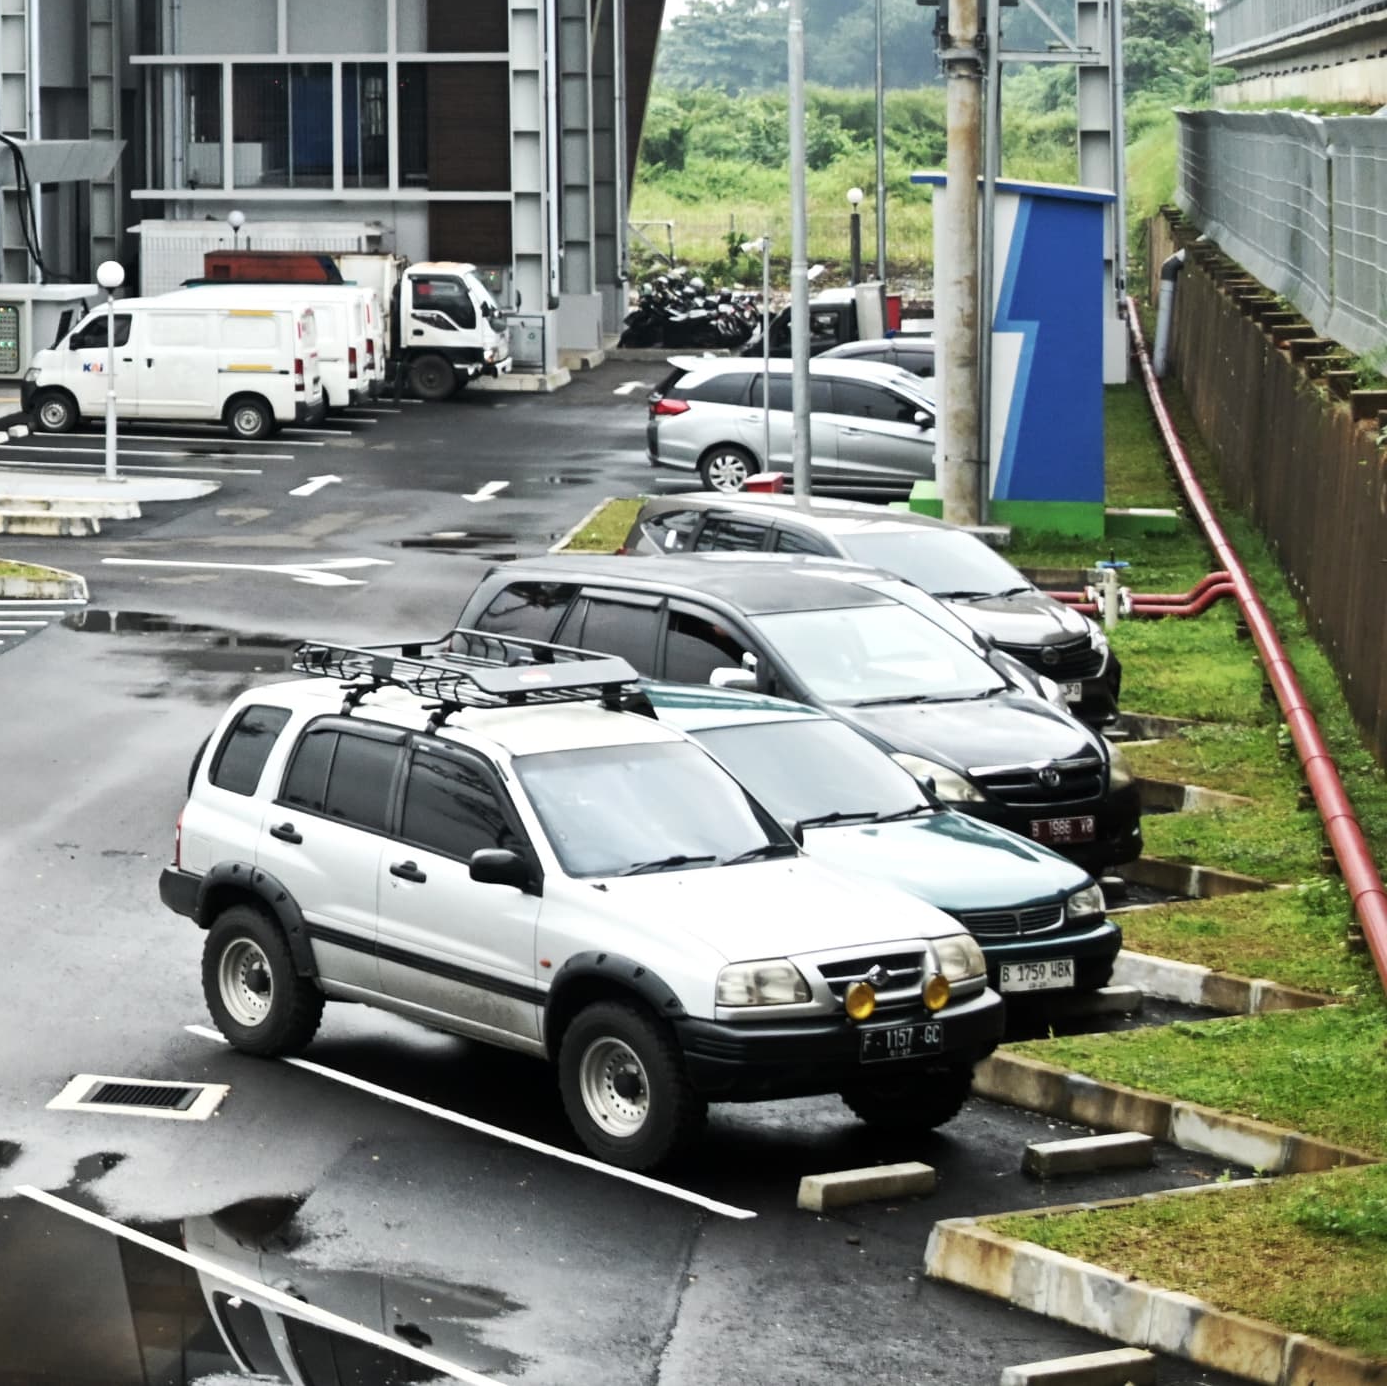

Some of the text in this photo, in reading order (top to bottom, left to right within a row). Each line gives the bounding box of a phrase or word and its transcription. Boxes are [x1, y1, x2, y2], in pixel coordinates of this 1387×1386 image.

[1002, 966, 1010, 983] B
[1017, 963, 1046, 982] 1759
[886, 1027, 914, 1049] 1157
